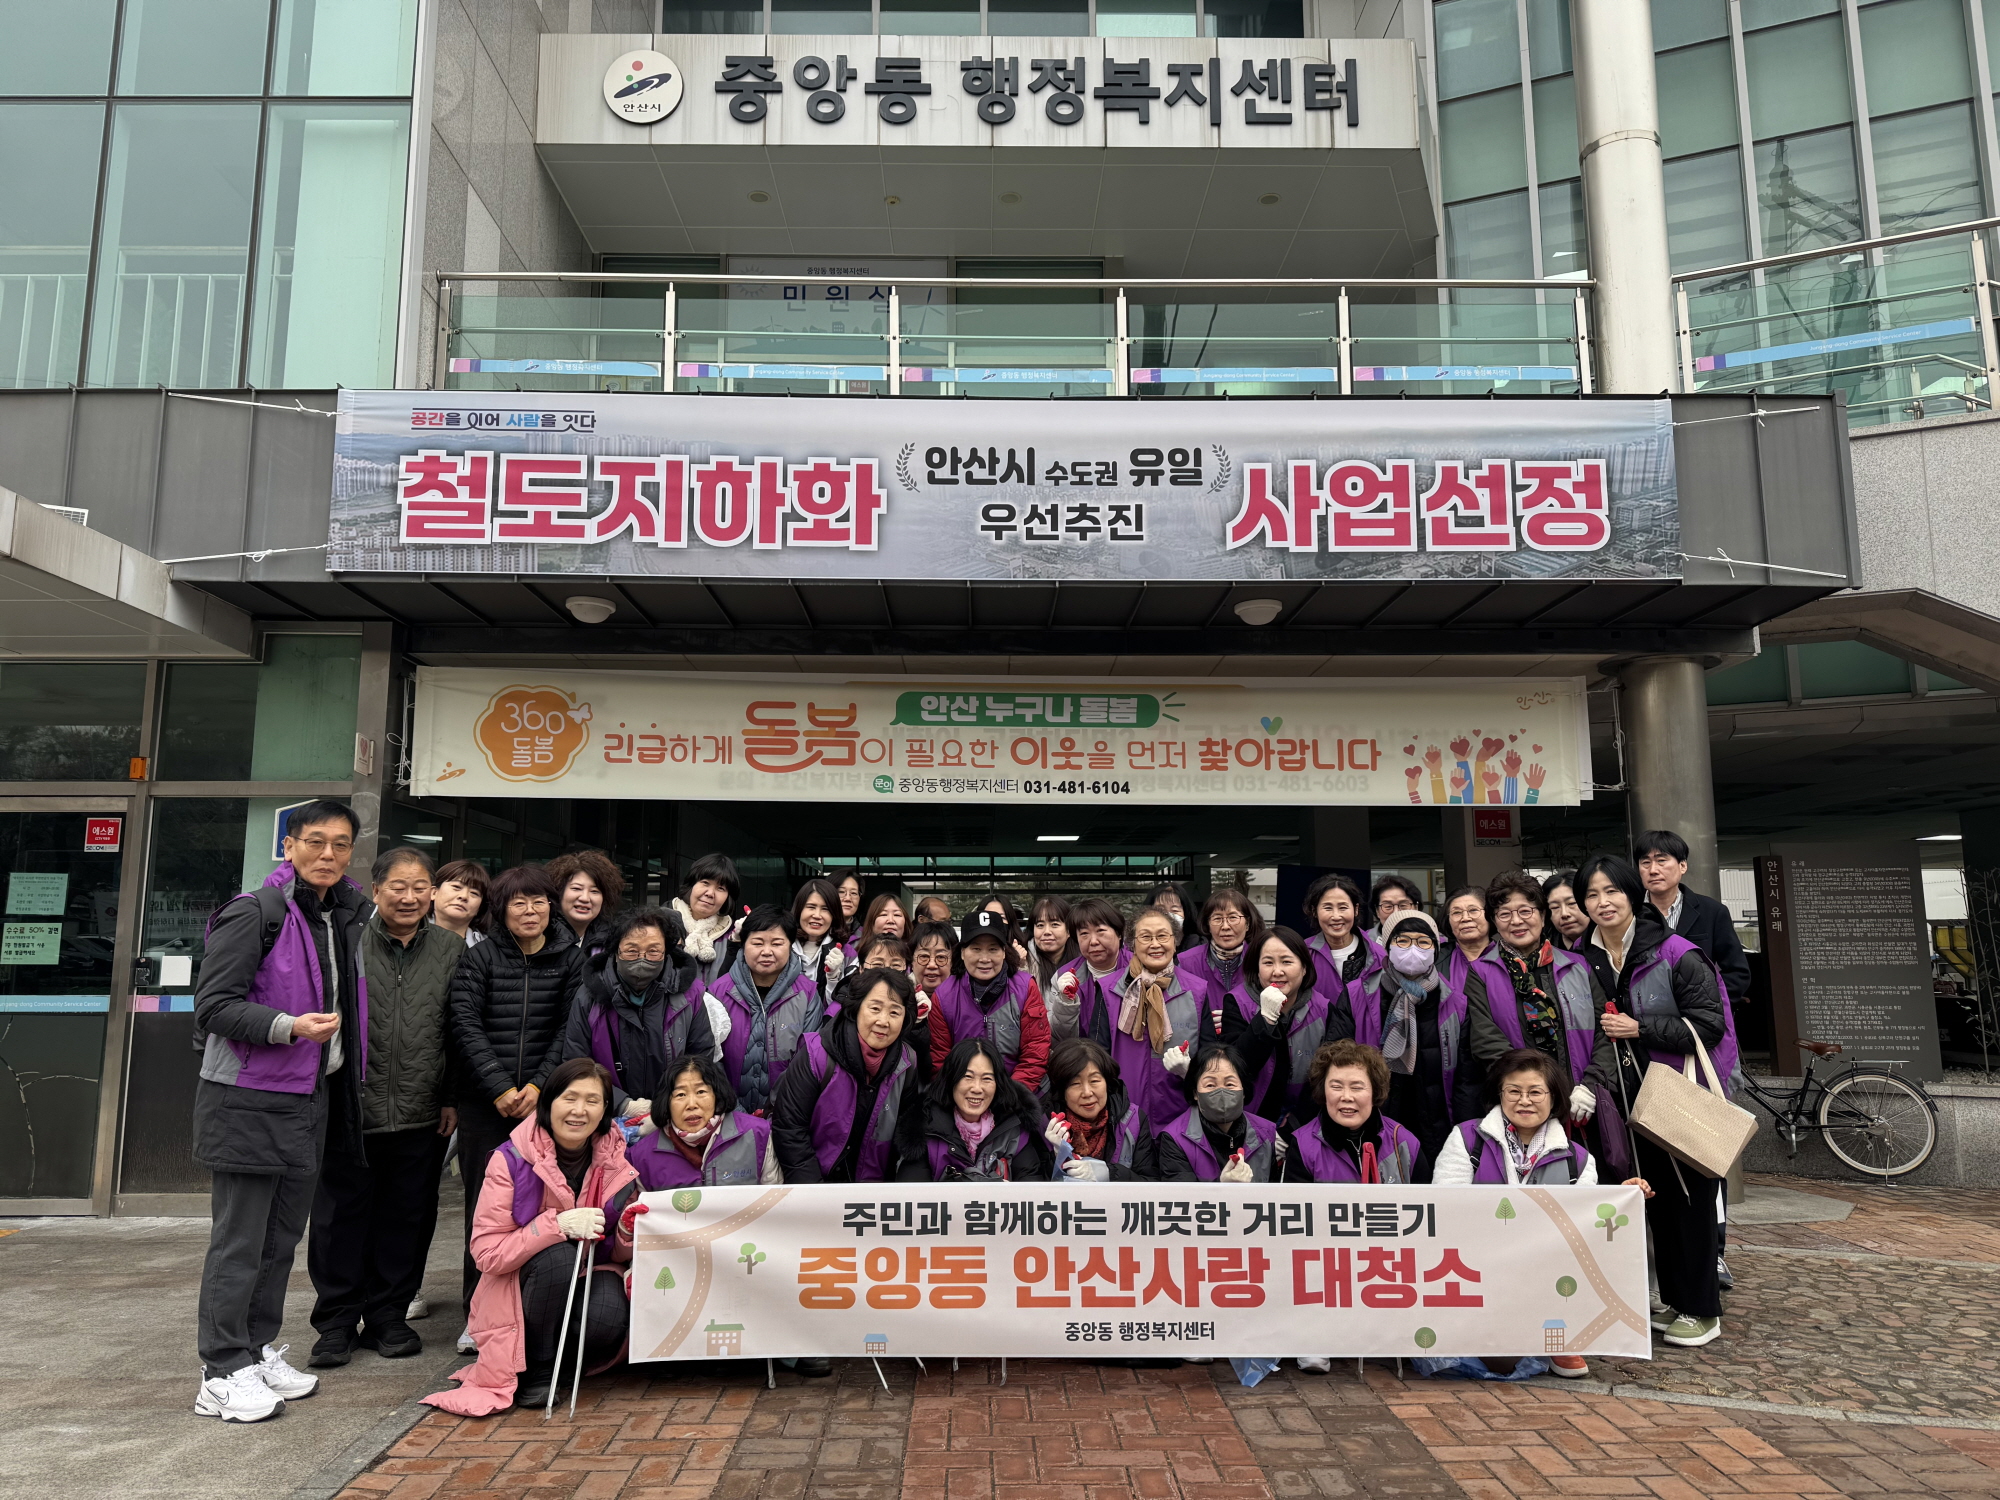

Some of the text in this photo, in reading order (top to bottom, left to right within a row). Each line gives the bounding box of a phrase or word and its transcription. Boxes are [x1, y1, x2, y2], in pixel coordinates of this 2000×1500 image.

[715, 54, 1359, 127] 중앙동 행정복지센터
[622, 102, 662, 113] 안산시
[806, 267, 870, 276] 중앙동 행정복지센터
[1849, 336, 1881, 346] Community
[1001, 371, 1019, 379] 중앙동
[1203, 372, 1235, 380] Jungang-dong
[411, 411, 461, 426] 공간을
[467, 412, 500, 427] 이어
[506, 413, 556, 428] 사람을
[925, 446, 1203, 487] 안산시 수도권 유일
[399, 450, 886, 549] 철도지하화
[1229, 460, 1609, 551] 사업선정
[980, 503, 1144, 541] 우선추진
[500, 700, 565, 734] 360
[920, 695, 1138, 723] 안산 누구나 돌봄
[511, 736, 554, 768] 돌봄
[603, 730, 732, 764] 긴급하게
[741, 701, 893, 773] 돌봄이
[906, 738, 999, 768] 필요한
[1010, 737, 1116, 770] 이웃을
[1127, 741, 1186, 770] 먼저
[1198, 737, 1382, 772] 찾아갑니다
[874, 778, 1130, 795] 문의 중앙동행정복지센터 031-481-6104
[92, 826, 115, 836] 에스원
[1480, 819, 1506, 830] 에스원
[1767, 861, 1782, 932] 안산시 유래
[979, 912, 990, 926] C
[1674, 1105, 1719, 1137] TORY BURCH
[843, 1200, 1436, 1237] 주민과 함께하는 깨끗한 거리 만들기
[797, 1246, 1484, 1310] 중앙동 안산사랑 대청소
[1065, 1321, 1215, 1342] 중앙동 행정복지센터
